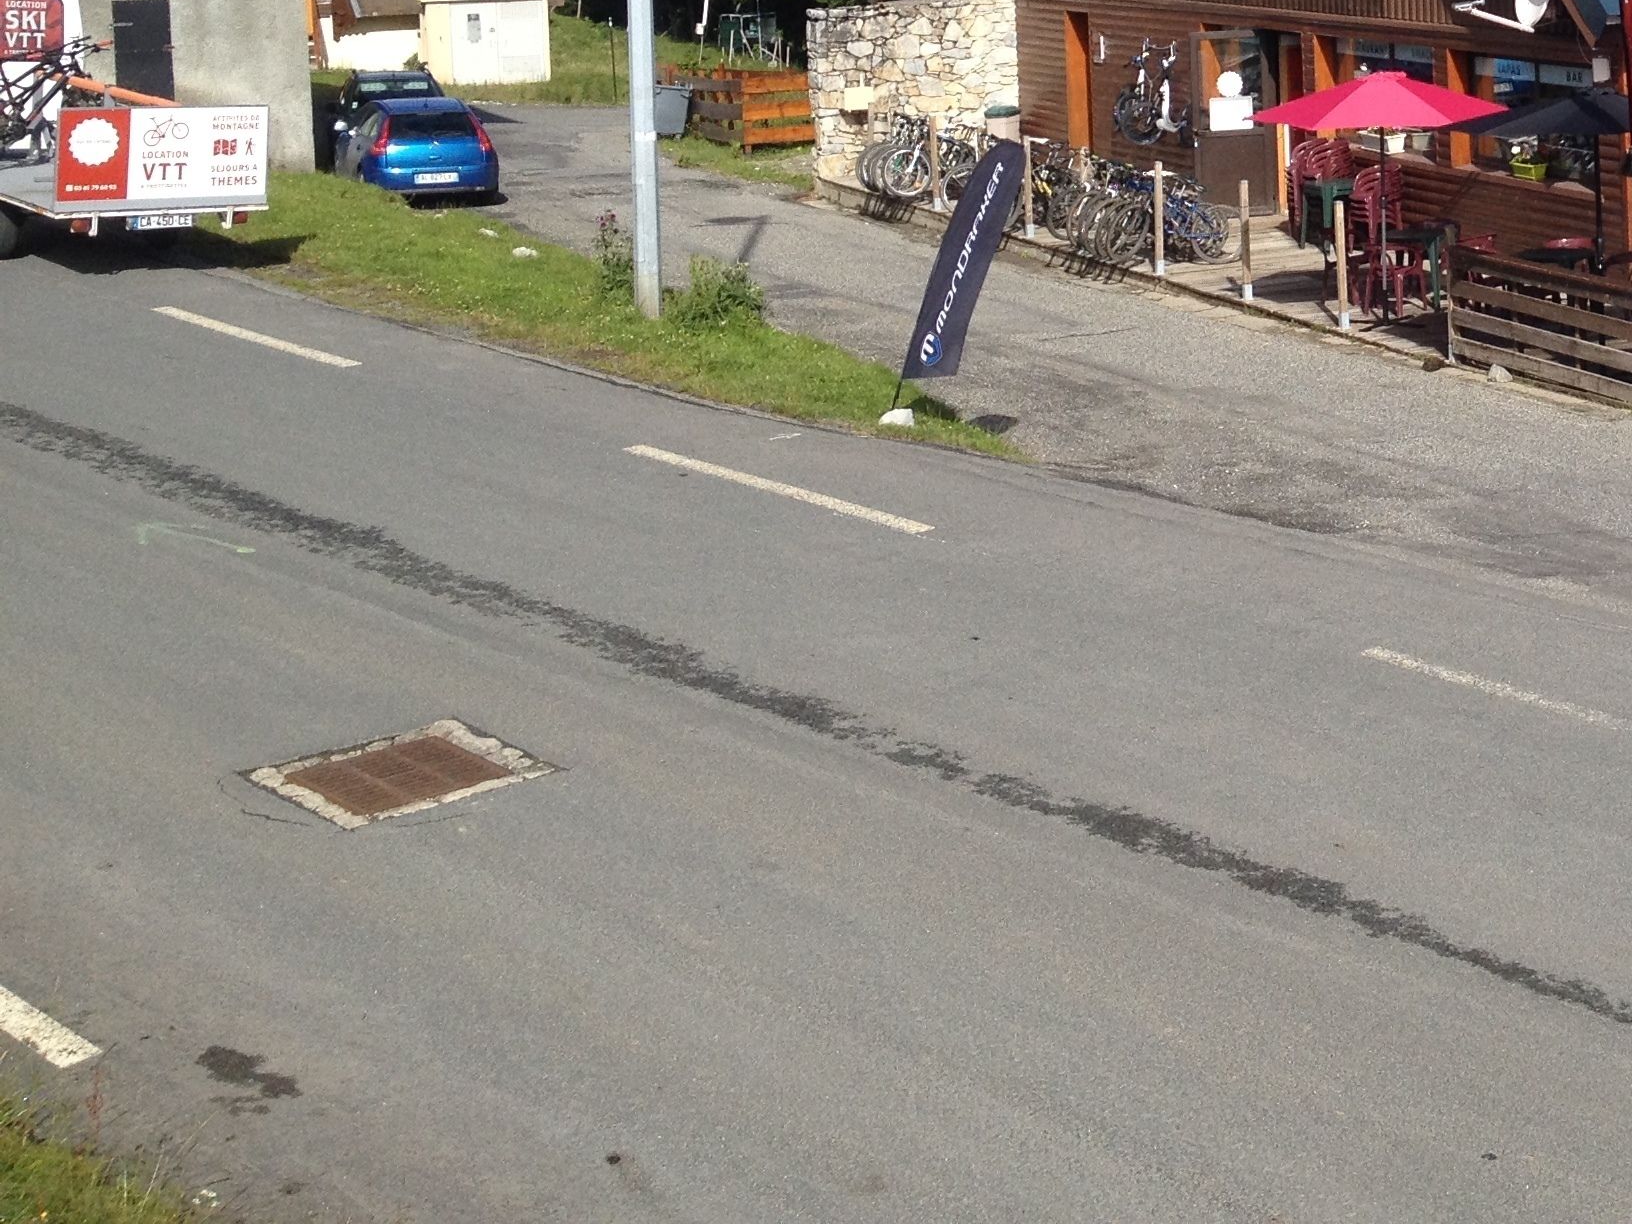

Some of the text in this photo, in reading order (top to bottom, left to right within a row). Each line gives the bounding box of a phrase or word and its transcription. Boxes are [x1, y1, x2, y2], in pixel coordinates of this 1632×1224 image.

[5, 0, 47, 9] LOCATION
[5, 9, 46, 30] SKI
[4, 31, 46, 48] VTT
[1566, 71, 1583, 82] BAR
[212, 122, 260, 130] MONTAGNE
[142, 150, 189, 159] LOCATION
[142, 162, 188, 181] VTT
[935, 161, 1004, 334] MONDRAKER
